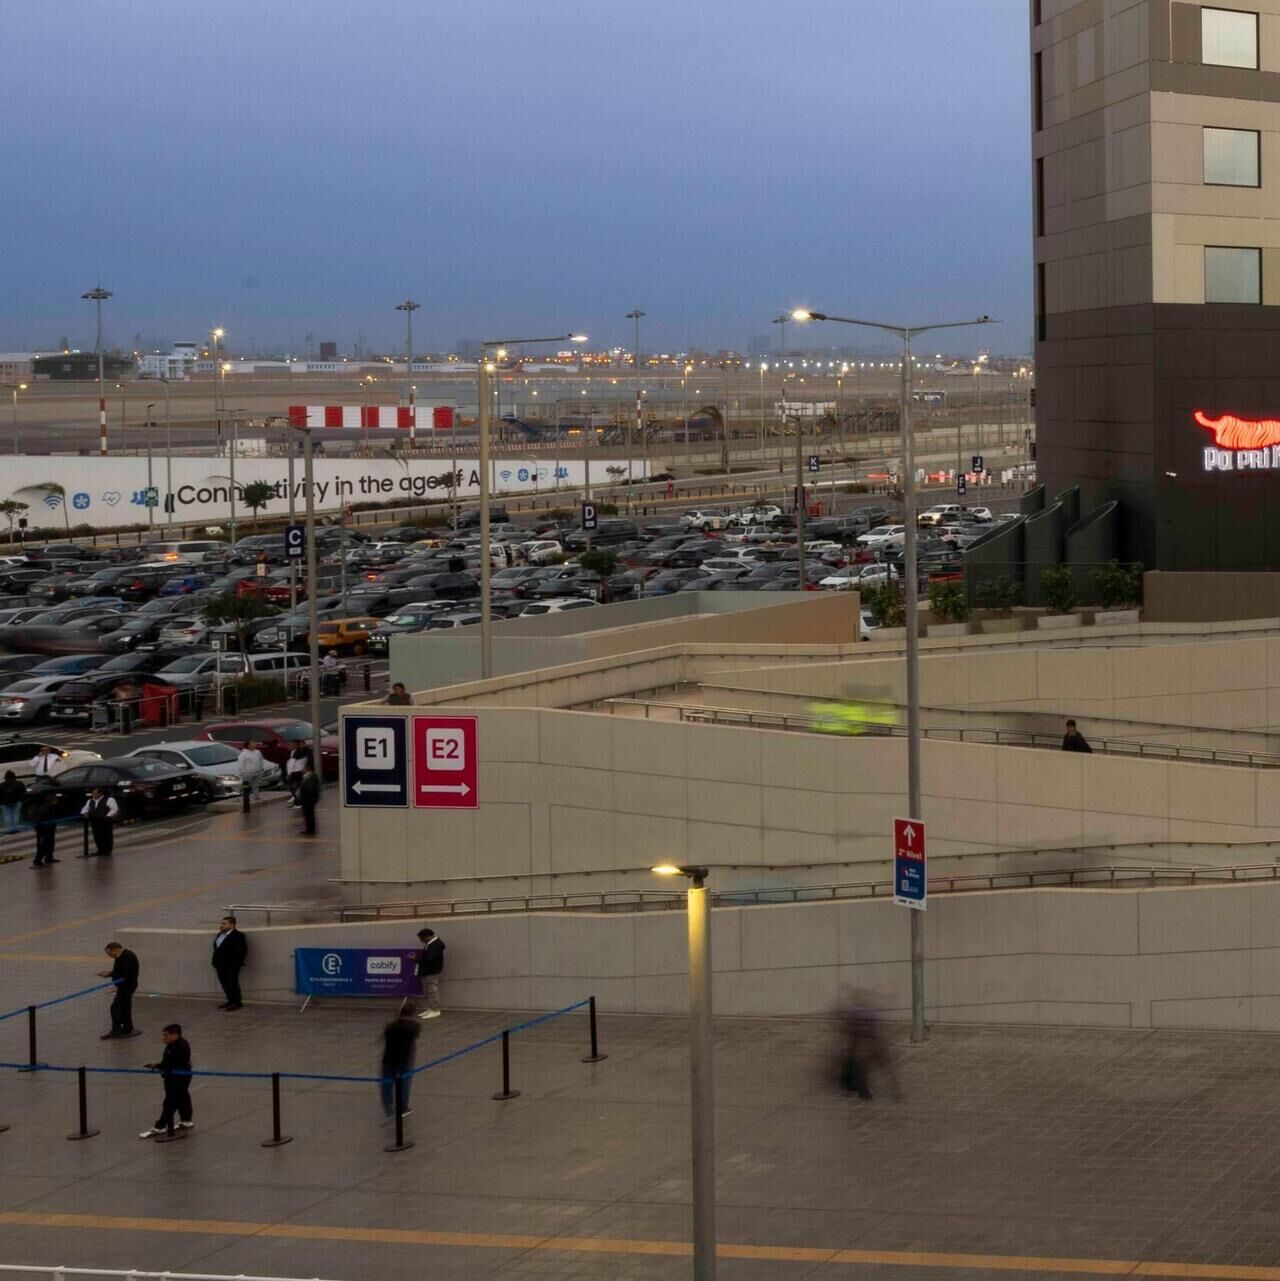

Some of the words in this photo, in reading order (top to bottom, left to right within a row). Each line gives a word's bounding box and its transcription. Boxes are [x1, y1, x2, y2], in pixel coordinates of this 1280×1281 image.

[335, 475, 353, 496] in
[359, 475, 395, 494] the
[585, 506, 594, 520] D
[289, 529, 302, 545] C
[364, 738, 387, 758] E1
[432, 738, 459, 759] E2
[370, 960, 398, 971] cabify
